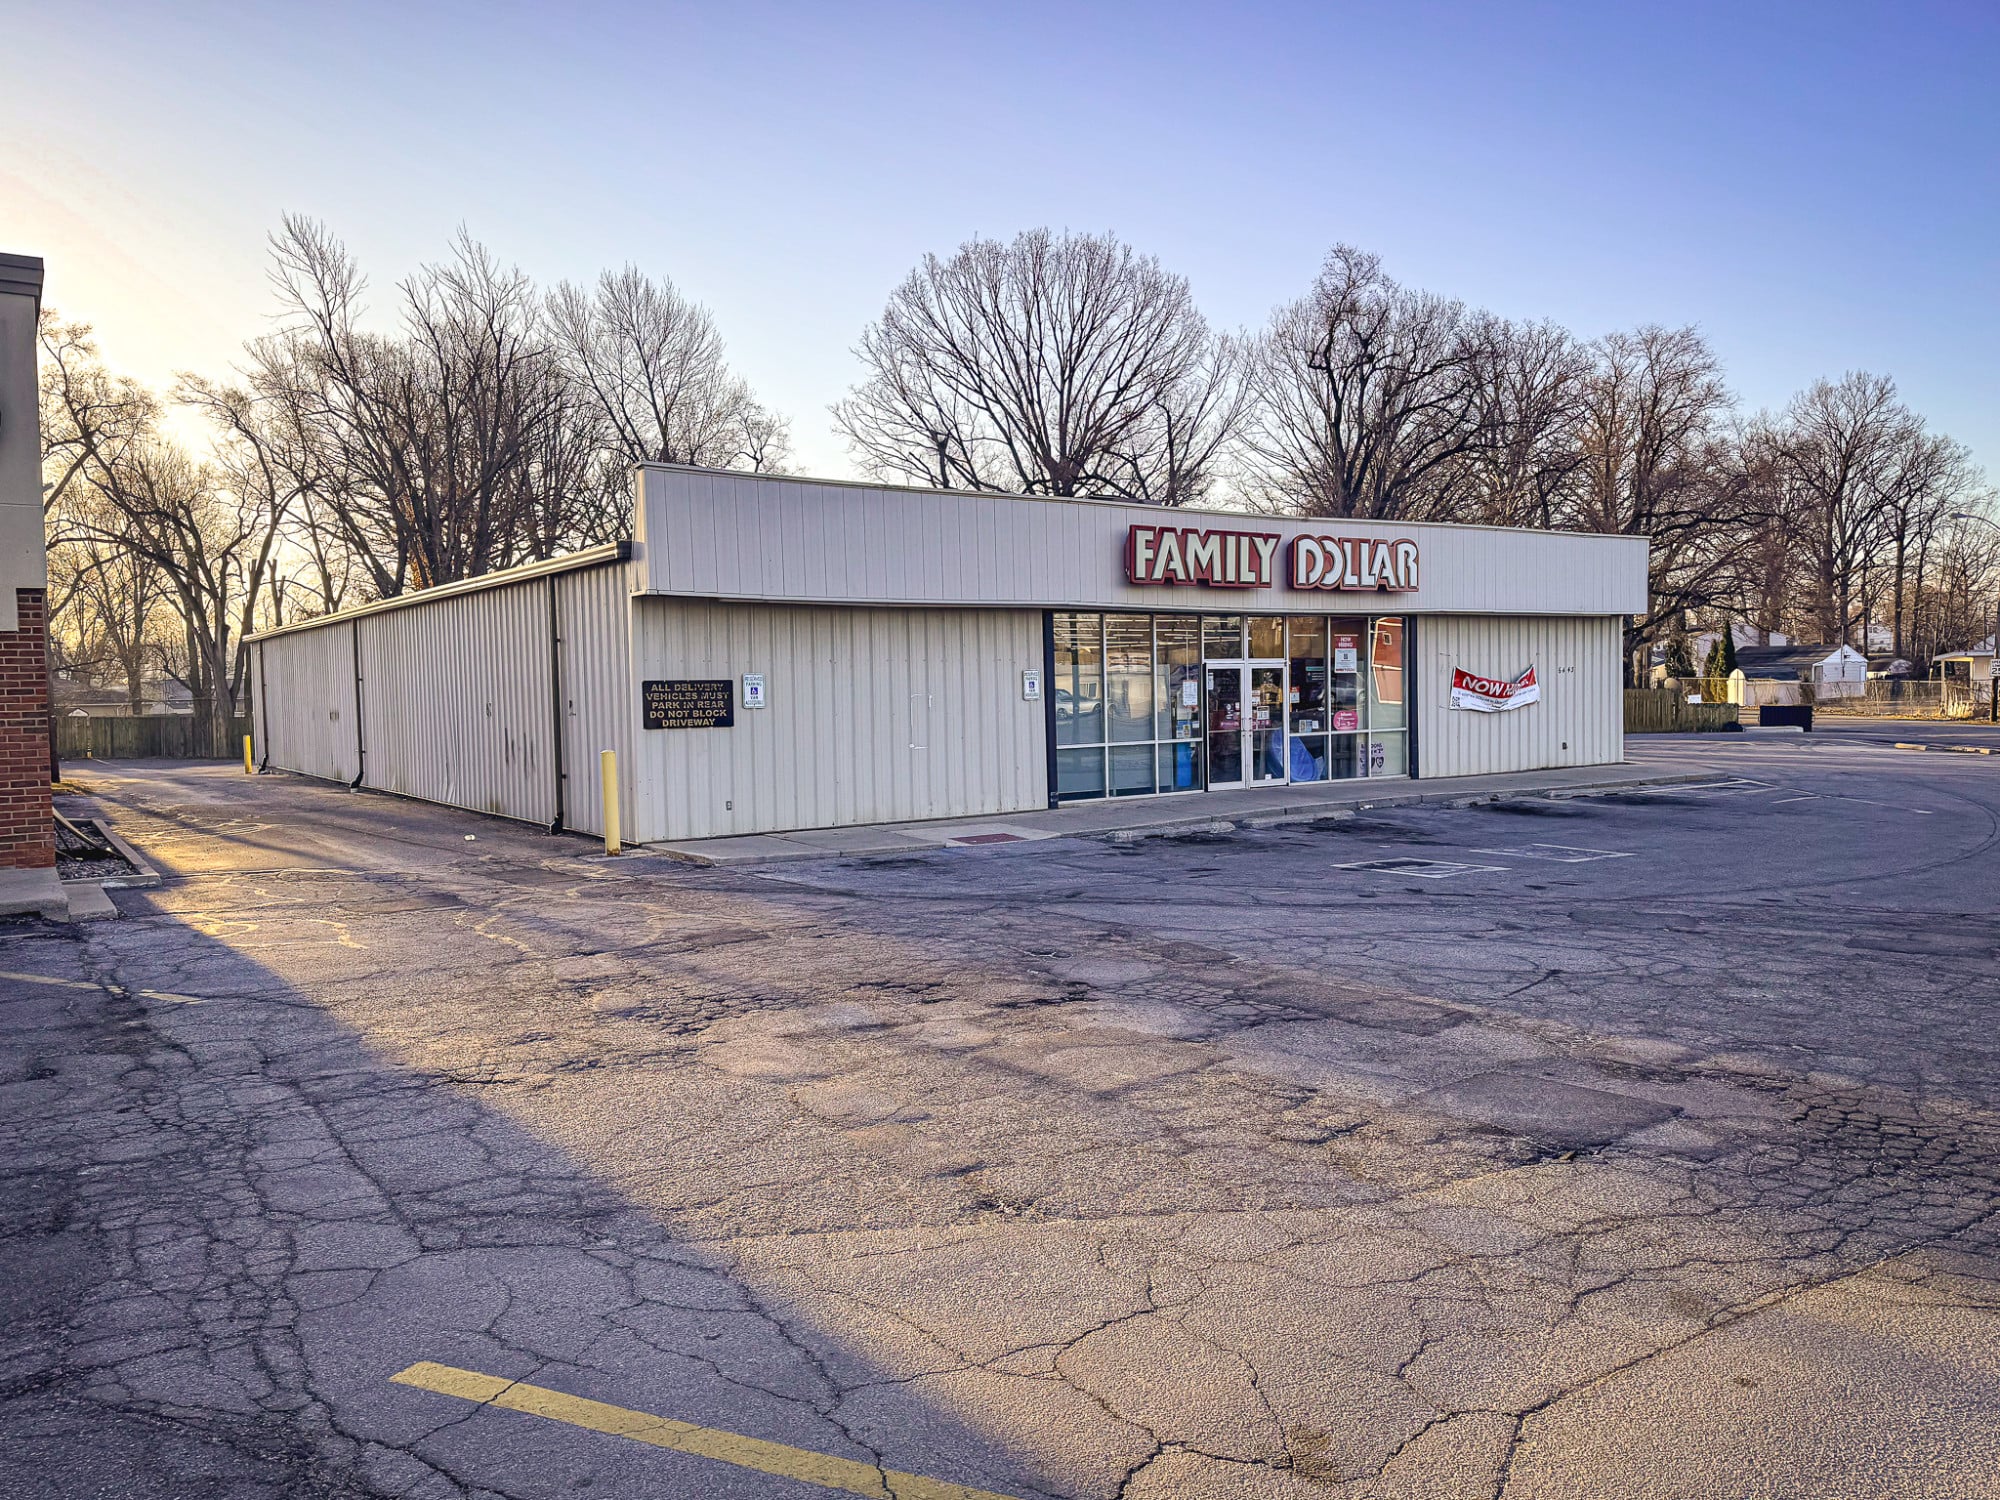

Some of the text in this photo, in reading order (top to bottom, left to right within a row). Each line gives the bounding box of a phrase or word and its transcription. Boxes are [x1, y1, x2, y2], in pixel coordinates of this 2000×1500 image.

[1134, 529, 1418, 588] FAMILY DOLLAR
[651, 683, 724, 692] ALL DELIVERY
[1462, 676, 1504, 696] NOW
[646, 691, 729, 700] VEHICLES MUST
[651, 700, 725, 709] PARK IN REAR
[668, 710, 690, 718] NOT
[692, 709, 727, 717] BLOCK
[662, 718, 716, 727] DRIVEWAY
